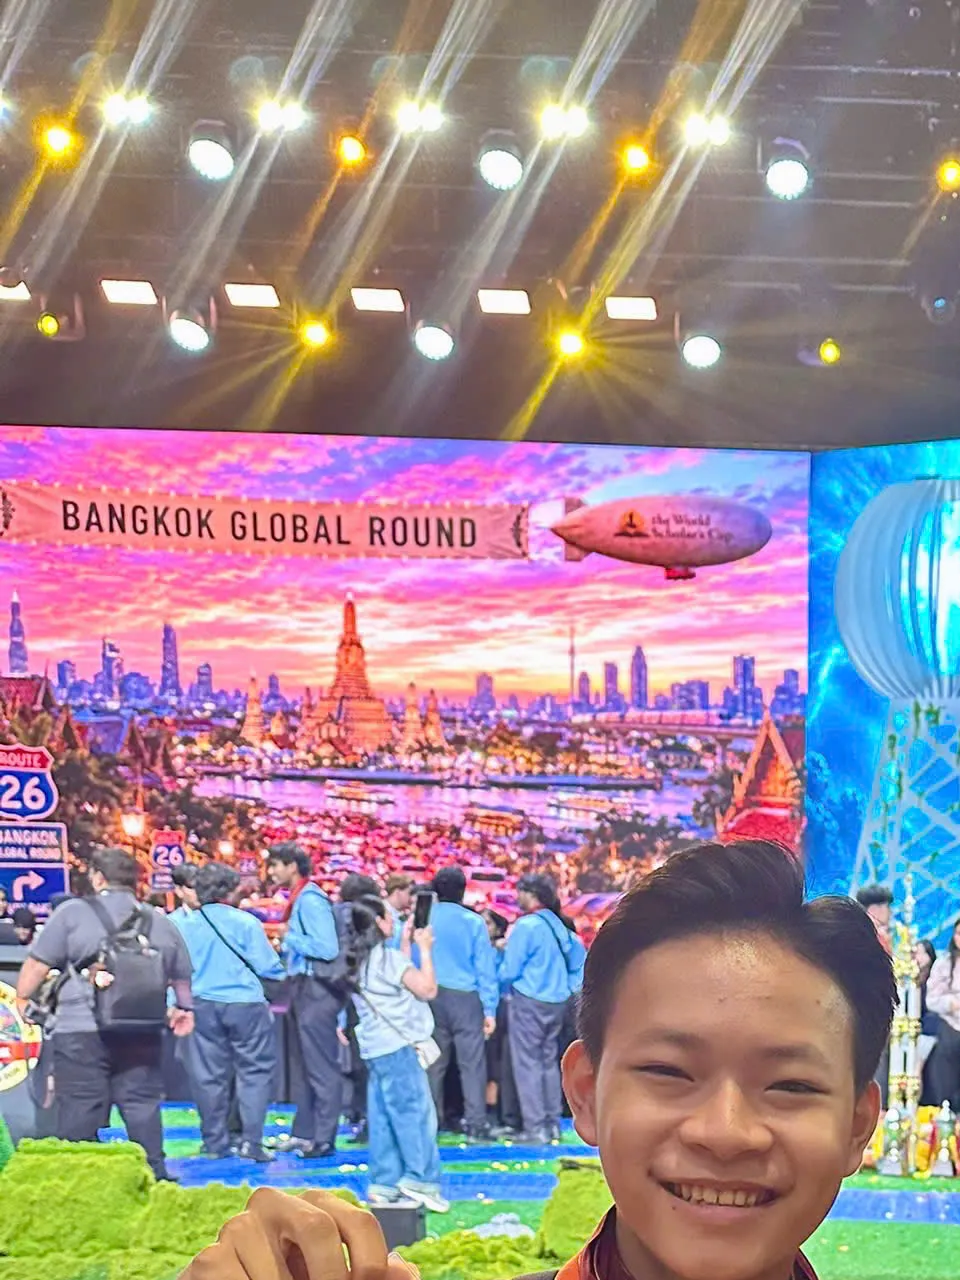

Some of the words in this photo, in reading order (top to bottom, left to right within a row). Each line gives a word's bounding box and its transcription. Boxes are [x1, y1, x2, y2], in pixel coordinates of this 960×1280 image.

[61, 500, 216, 539] BANGKOK
[230, 510, 351, 546] GLOBAL
[369, 516, 477, 548] ROUND
[0, 775, 46, 810] 26
[156, 847, 183, 866] 26
